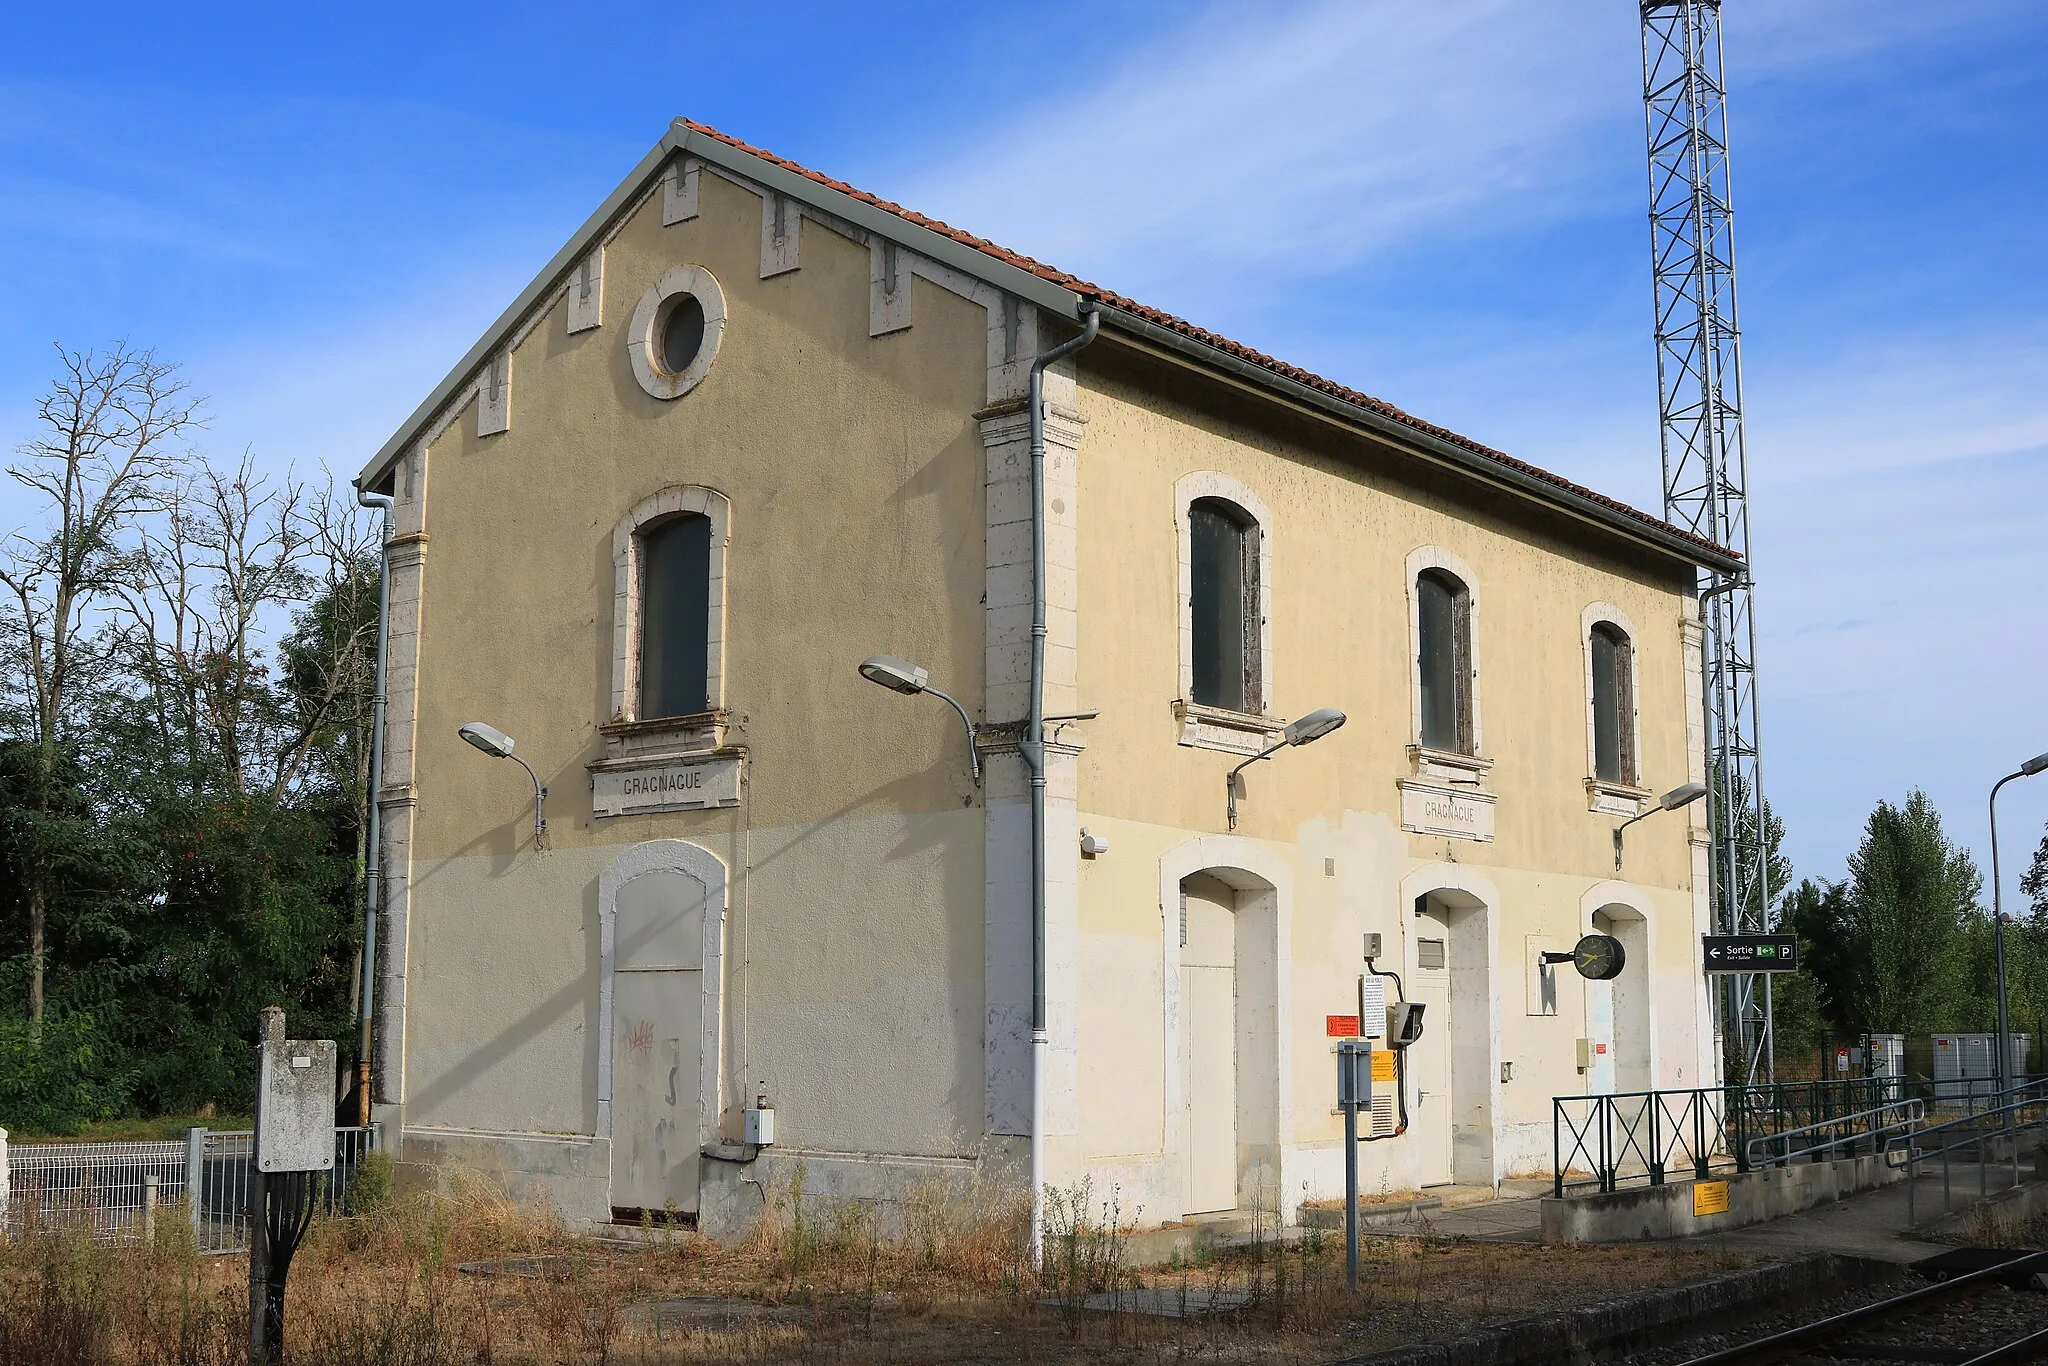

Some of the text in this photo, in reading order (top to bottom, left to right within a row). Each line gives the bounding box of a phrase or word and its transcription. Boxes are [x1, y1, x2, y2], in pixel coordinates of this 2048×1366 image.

[624, 772, 701, 795] GRAGNAGUE
[1425, 801, 1474, 823] GRAGNAGUE
[1726, 945, 1790, 957] Sortie P
